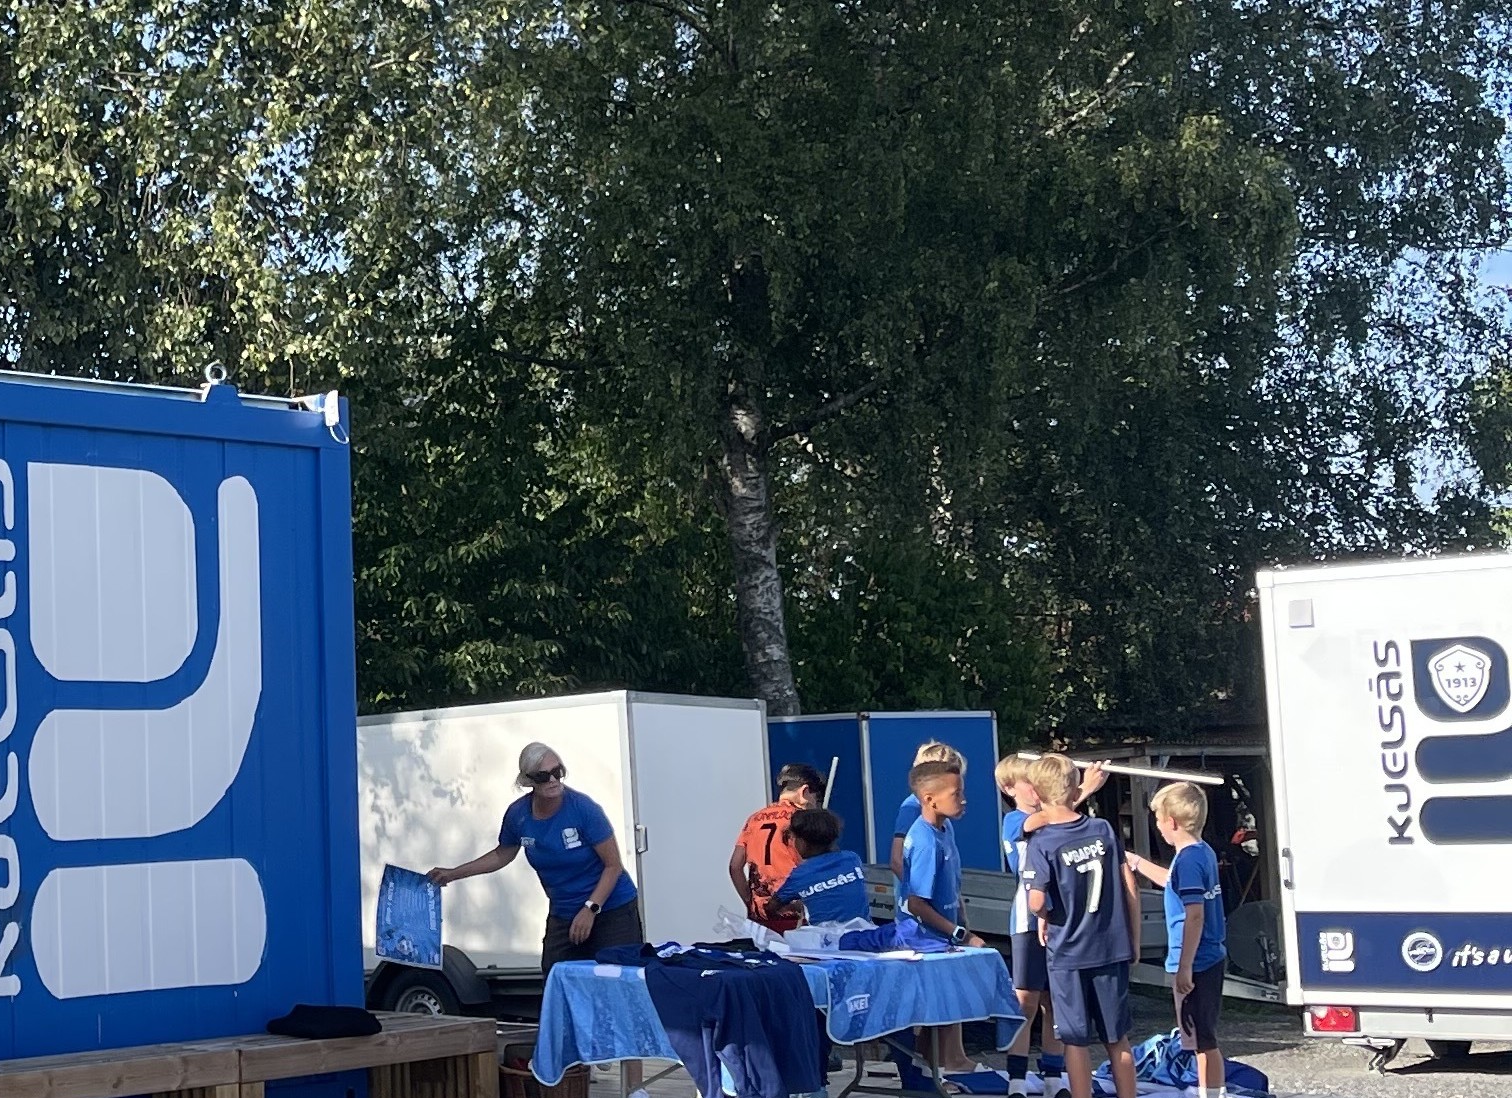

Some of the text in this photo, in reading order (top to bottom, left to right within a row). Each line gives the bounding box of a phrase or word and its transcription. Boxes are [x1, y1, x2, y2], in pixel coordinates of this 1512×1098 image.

[1444, 676, 1478, 689] 1913
[760, 822, 778, 866] 7
[1076, 859, 1103, 913] 7
[1451, 944, 1485, 967] it's
